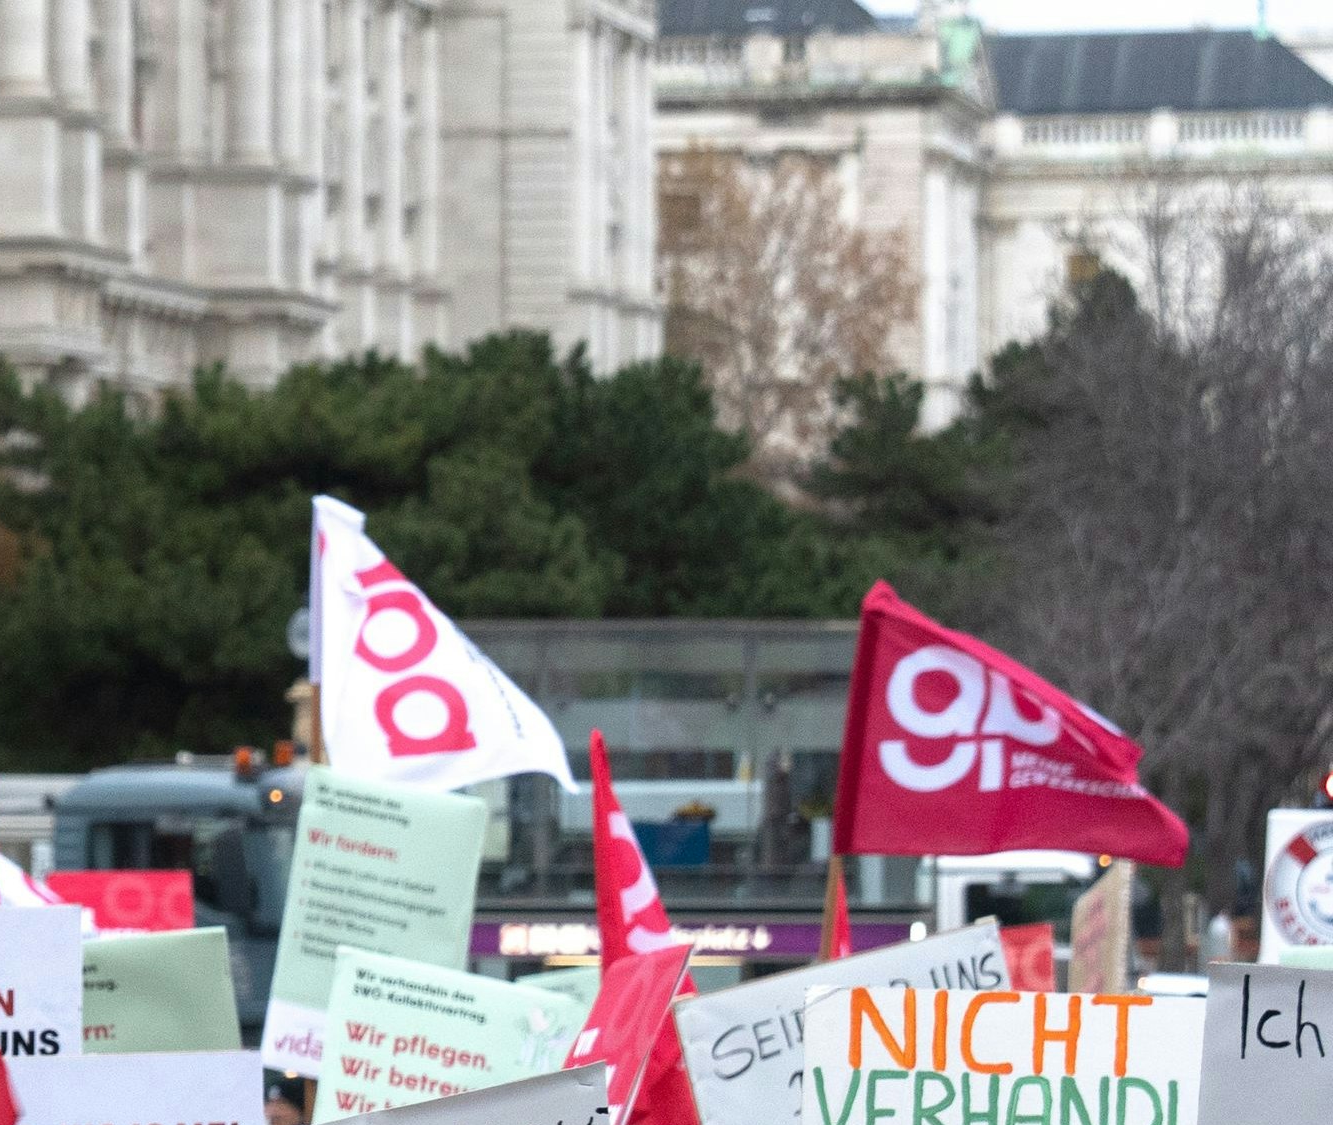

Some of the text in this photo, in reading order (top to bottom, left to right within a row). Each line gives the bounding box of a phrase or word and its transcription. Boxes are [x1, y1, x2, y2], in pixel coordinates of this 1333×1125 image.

[345, 1019, 493, 1073] Wir pflegen.
[847, 987, 1154, 1077] NICHT
[1240, 973, 1326, 1060] Ich
[340, 1054, 382, 1082] Wir
